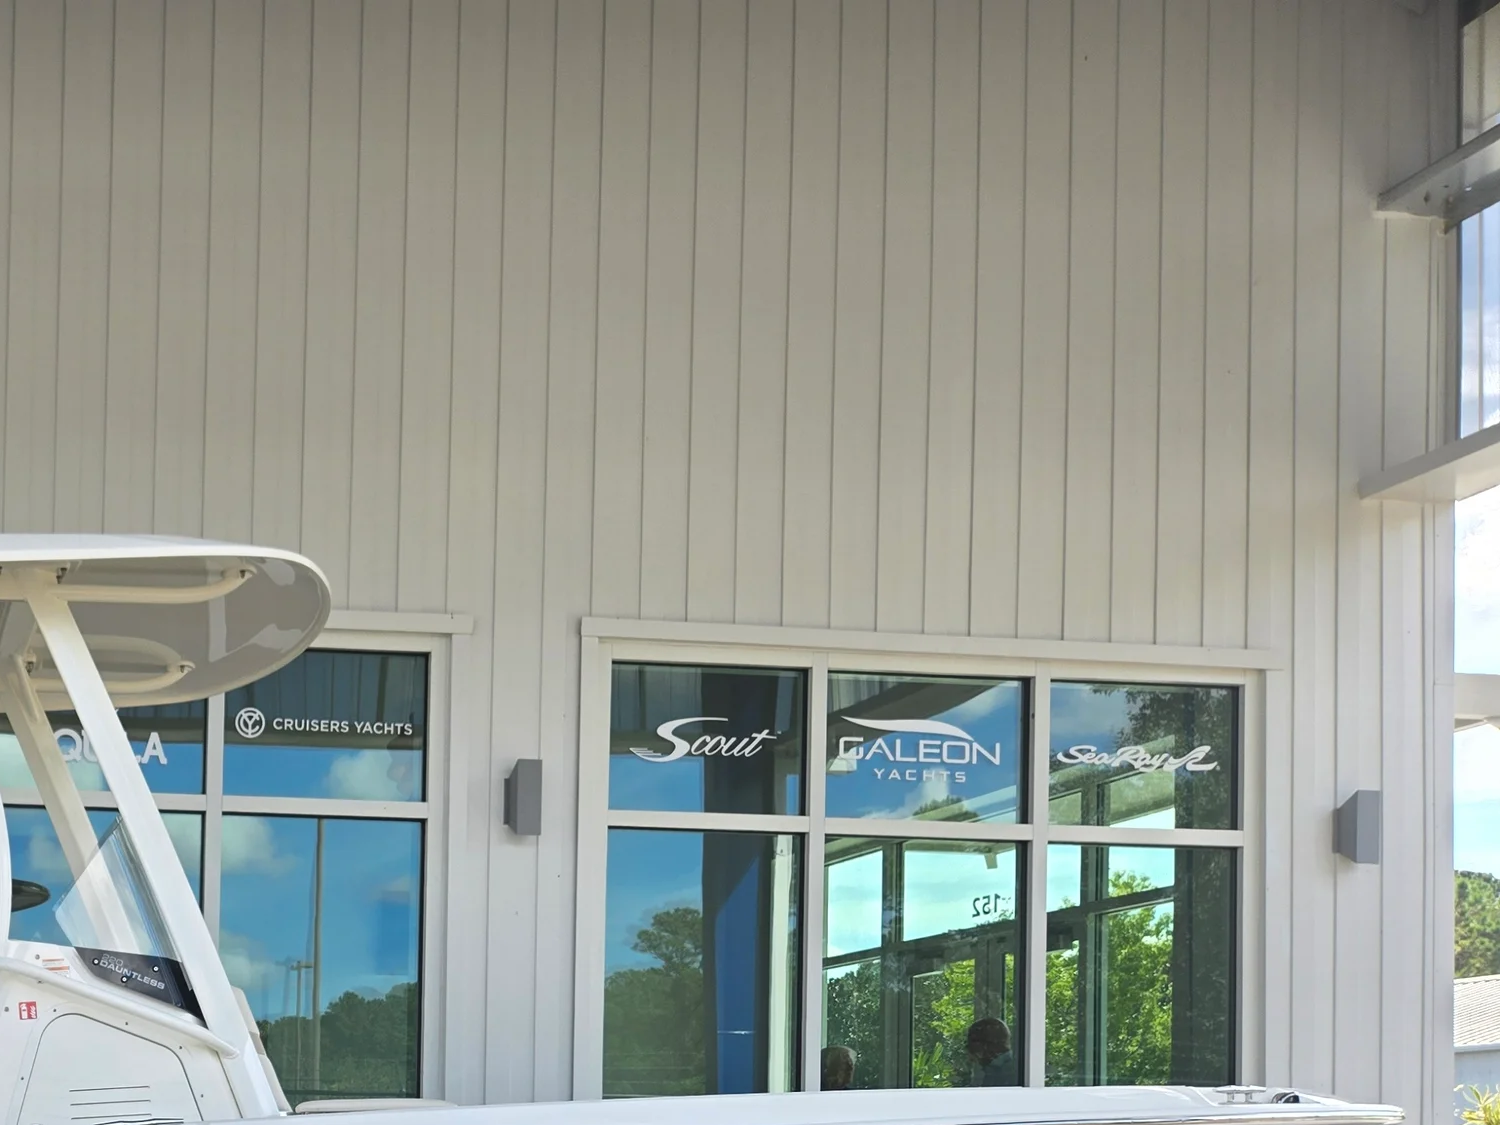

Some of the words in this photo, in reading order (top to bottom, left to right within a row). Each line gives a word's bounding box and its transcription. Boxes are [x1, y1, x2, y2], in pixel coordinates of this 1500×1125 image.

[272, 717, 350, 734] CRUISERS
[353, 721, 414, 736] YACHTS
[629, 716, 778, 763] Scout
[839, 736, 1001, 766] GALEON
[1056, 744, 1113, 765] Sea
[1109, 745, 1171, 773] Ray
[873, 768, 967, 783] YACHTS
[99, 959, 166, 990] DAUNTLESS
